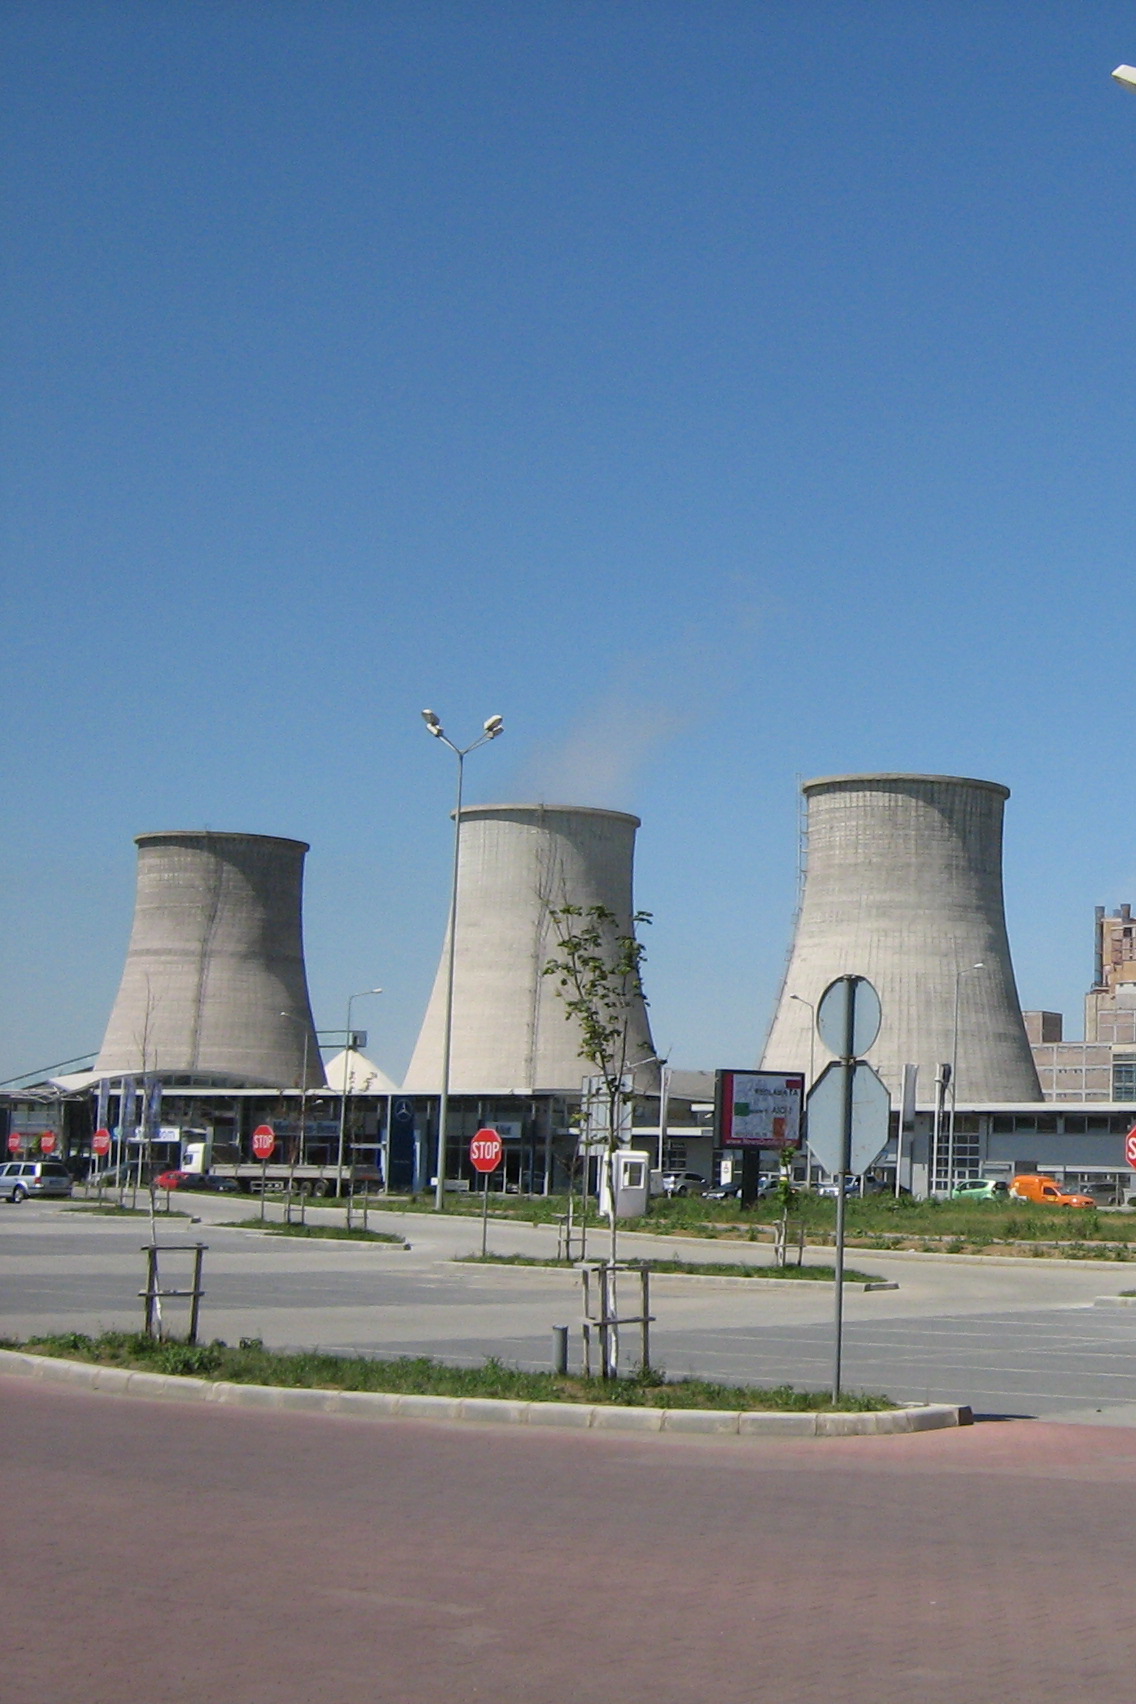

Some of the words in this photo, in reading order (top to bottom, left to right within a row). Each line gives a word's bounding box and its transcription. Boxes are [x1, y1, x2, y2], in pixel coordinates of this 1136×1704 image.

[41, 1137, 55, 1147] STOP
[93, 1136, 110, 1147] STOP
[253, 1135, 274, 1149] STOP
[471, 1141, 500, 1159] STOP
